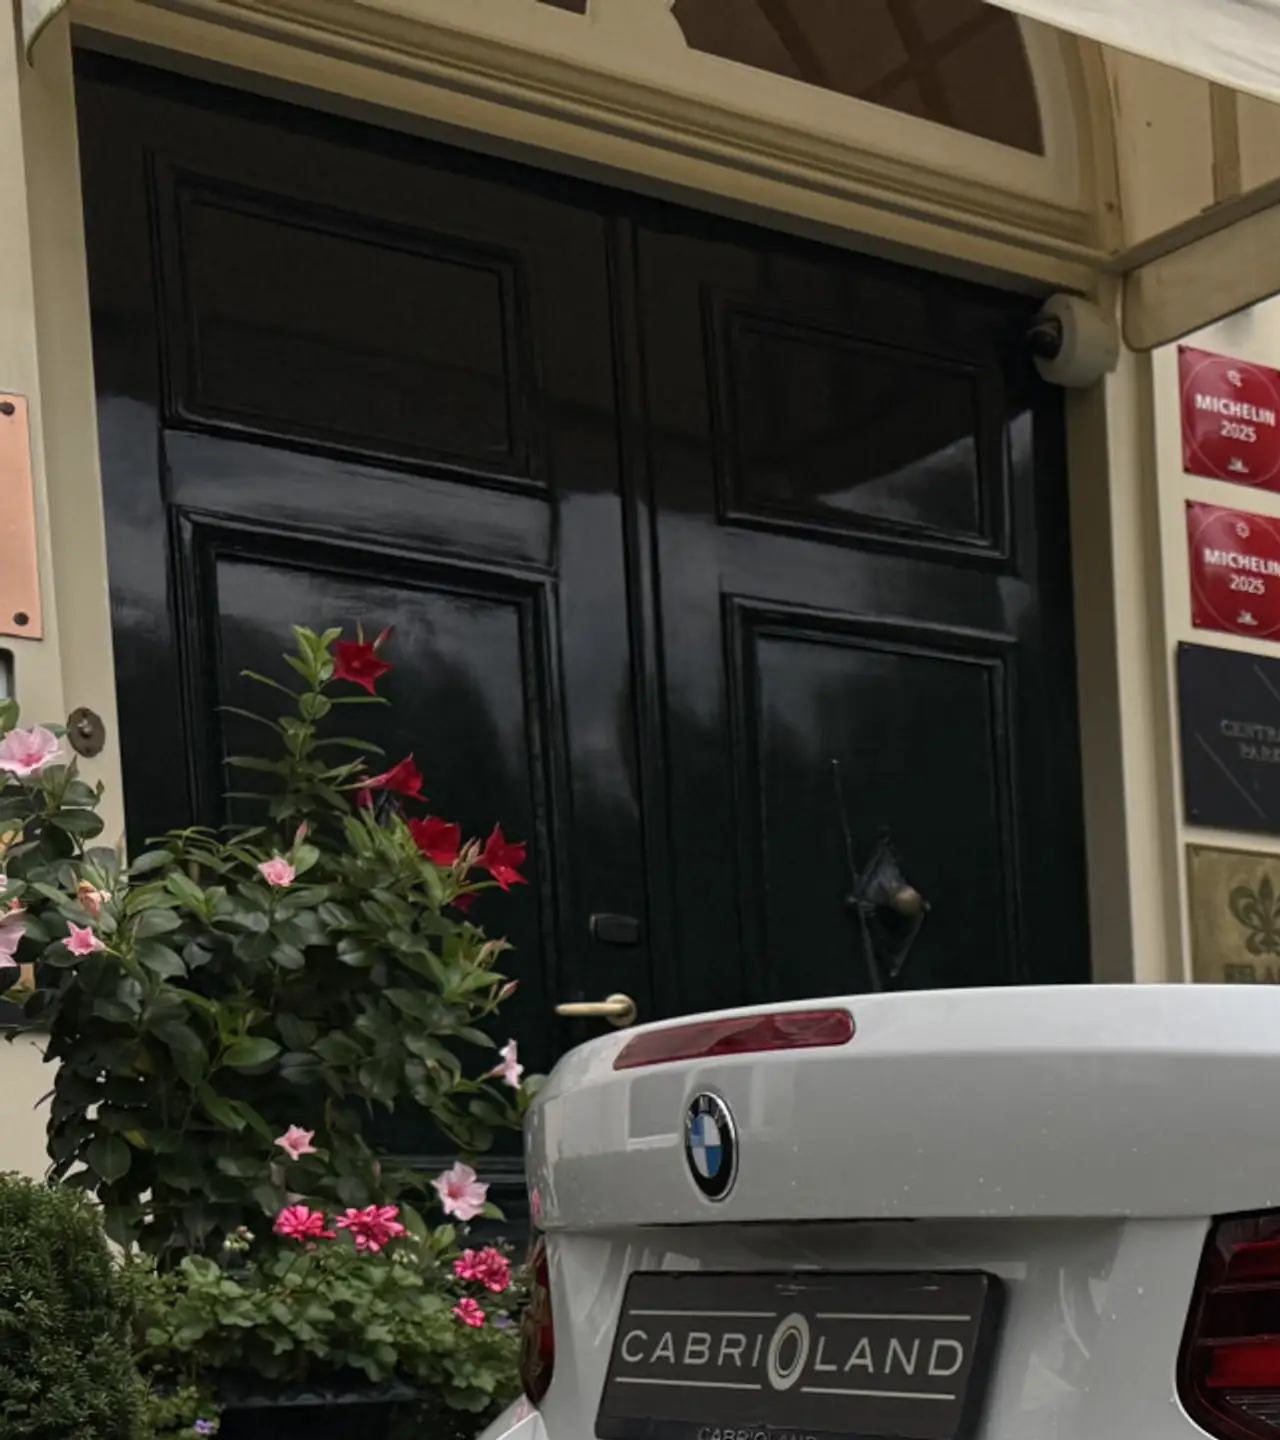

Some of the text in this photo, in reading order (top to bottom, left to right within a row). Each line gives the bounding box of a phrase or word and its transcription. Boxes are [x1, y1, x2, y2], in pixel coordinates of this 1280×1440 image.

[1194, 393, 1276, 427] MICHELIN
[1219, 420, 1257, 443] 2025
[1228, 573, 1266, 596] 2025
[620, 1313, 965, 1391] CABRIOLAND
